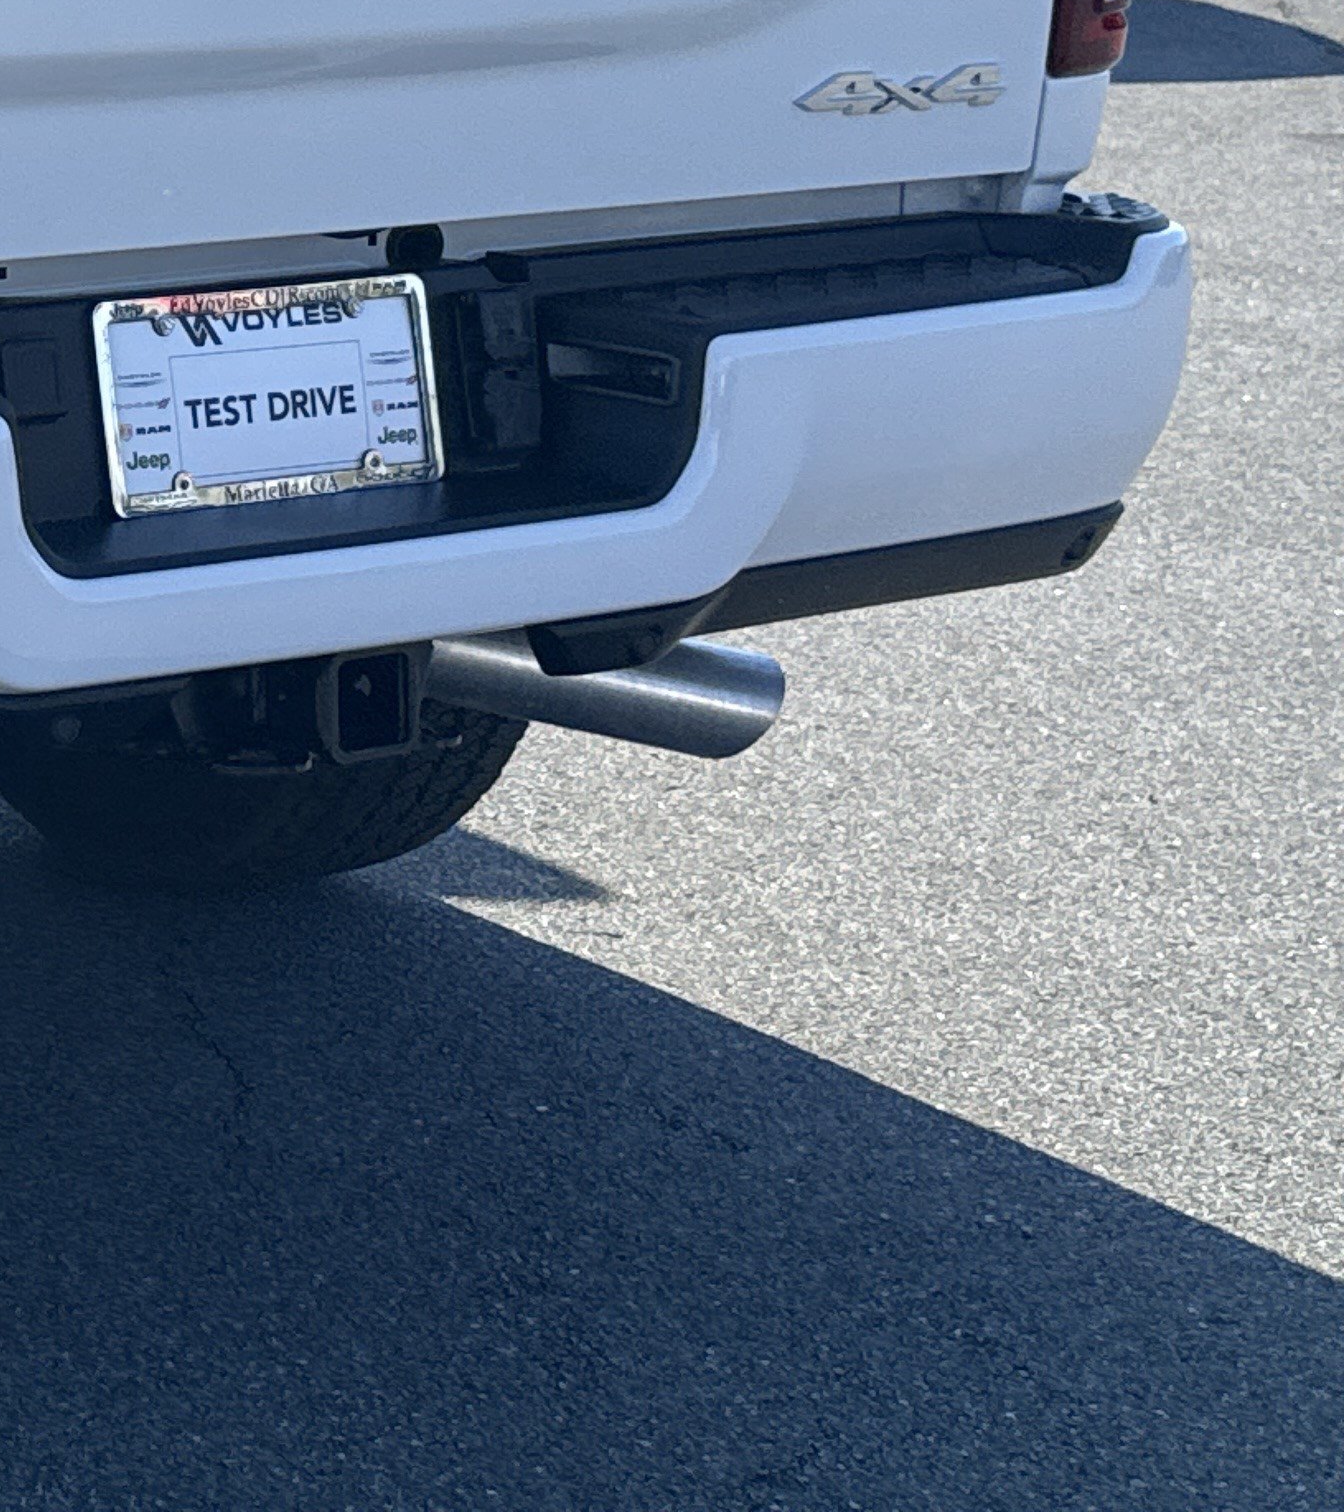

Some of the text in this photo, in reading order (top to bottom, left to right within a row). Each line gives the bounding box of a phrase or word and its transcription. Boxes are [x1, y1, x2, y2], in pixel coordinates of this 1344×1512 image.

[214, 301, 343, 332] VOYLES
[184, 384, 357, 429] TEST DRIVE
[136, 425, 171, 435] RAM
[378, 425, 418, 445] Jeep
[126, 451, 171, 470] Jeep
